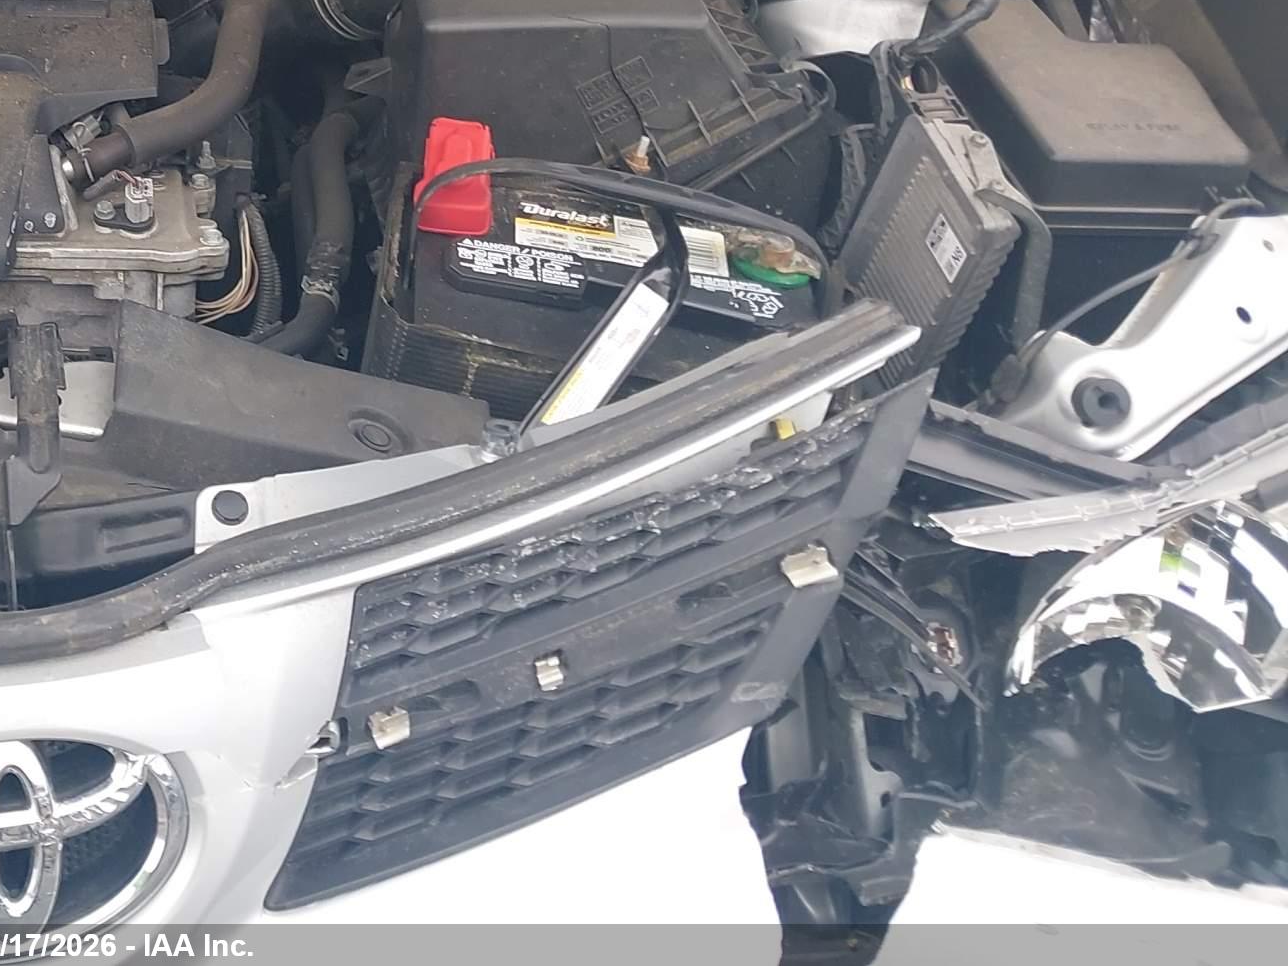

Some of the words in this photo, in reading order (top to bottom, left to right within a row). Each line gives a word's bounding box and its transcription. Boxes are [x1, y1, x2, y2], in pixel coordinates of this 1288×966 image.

[519, 201, 611, 227] Duralast
[473, 239, 521, 255] DANGER
[530, 248, 574, 262] POISON
